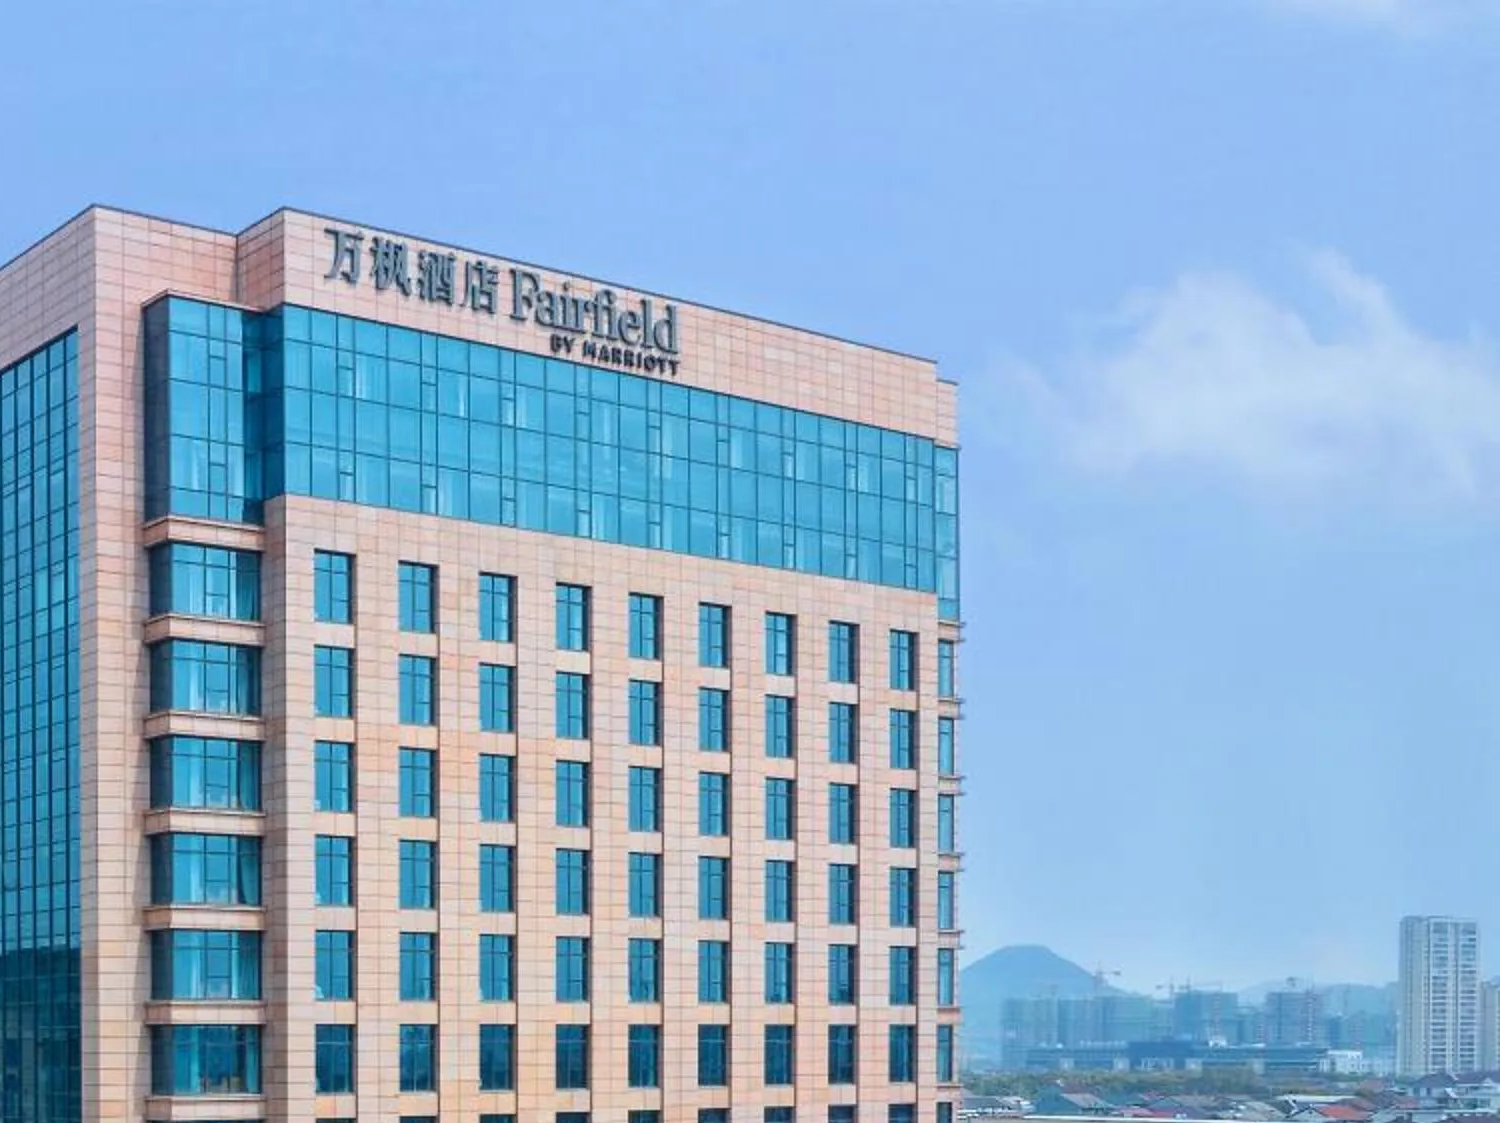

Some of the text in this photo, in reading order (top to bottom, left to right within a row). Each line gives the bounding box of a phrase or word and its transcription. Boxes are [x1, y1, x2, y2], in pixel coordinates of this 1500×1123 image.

[324, 228, 498, 314] 万枫酒店
[510, 268, 678, 354] Fairfield
[550, 333, 679, 376] BY MARRIOTT
